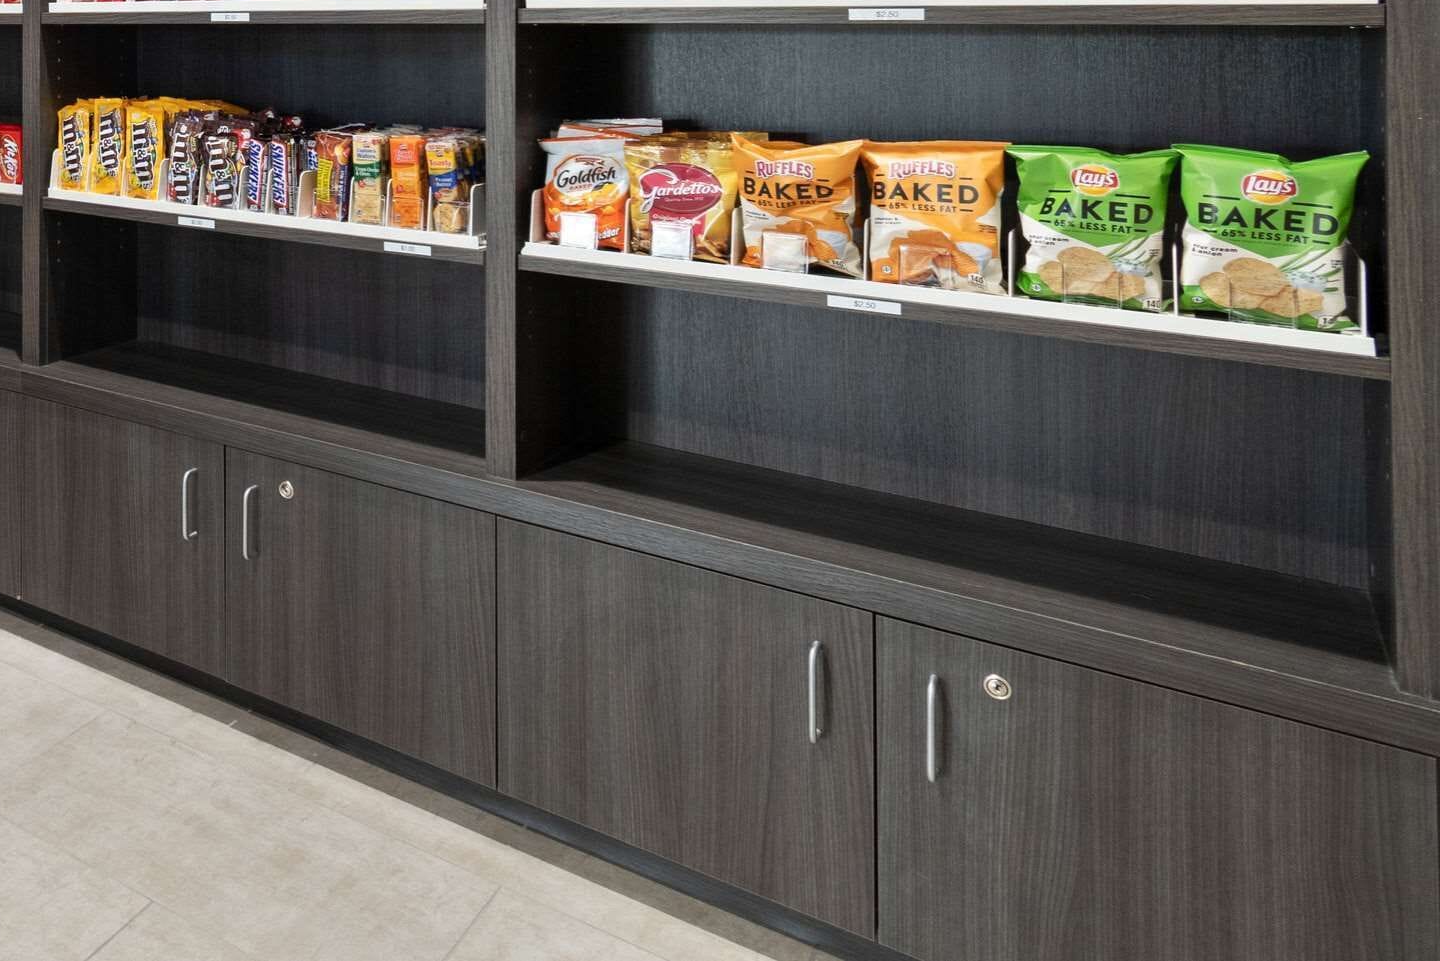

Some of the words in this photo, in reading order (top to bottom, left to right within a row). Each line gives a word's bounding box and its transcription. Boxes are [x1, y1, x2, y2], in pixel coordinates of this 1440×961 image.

[247, 139, 262, 202] SNICKERS
[271, 143, 285, 205] SNICKERS
[556, 167, 616, 188] Goldfish
[756, 160, 813, 179] RUFFLES
[889, 160, 955, 179] RUFFLES
[744, 177, 834, 200] BAKED
[873, 181, 980, 204] BAKED
[912, 204, 936, 212] LESS
[1040, 197, 1154, 225] BAKED
[1198, 202, 1339, 236] BAKED
[1080, 222, 1107, 232] LESS
[1111, 225, 1133, 234] FAT
[1221, 228, 1247, 238] 65%
[1250, 231, 1281, 241] LESS
[1286, 233, 1310, 245] FAT
